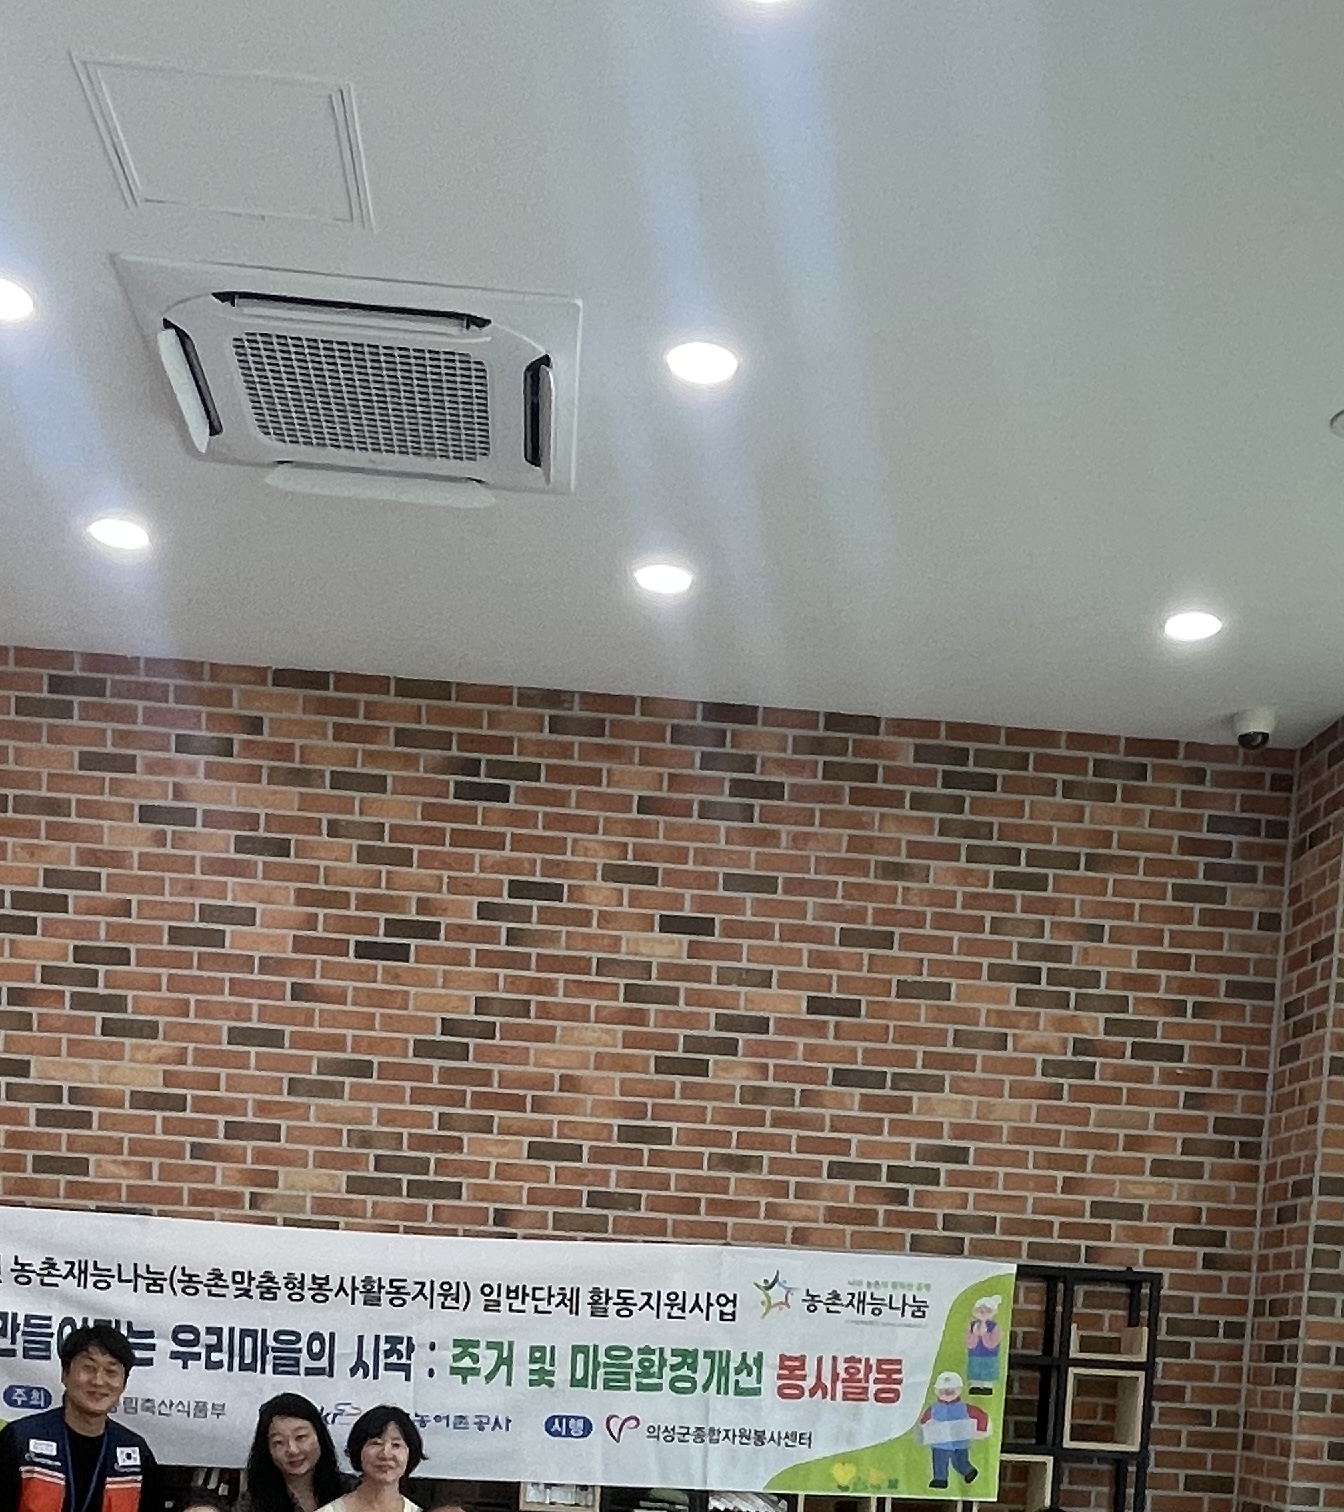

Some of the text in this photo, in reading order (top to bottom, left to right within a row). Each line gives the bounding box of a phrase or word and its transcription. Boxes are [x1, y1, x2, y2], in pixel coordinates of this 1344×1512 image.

[10, 1254, 471, 1312] 농촌재능나눔(농촌맞춤형봉사활동지원)
[479, 1282, 581, 1316] 일반단체
[587, 1286, 738, 1322] 활동지원사업
[801, 1288, 930, 1319] 농촌재능나눔
[169, 1324, 336, 1379] 우리마을의
[349, 1334, 416, 1382] 시작
[449, 1338, 515, 1388] 주거
[528, 1345, 556, 1388] 및
[569, 1343, 764, 1397] 마을환경개선
[776, 1353, 904, 1404] 봉사활동
[550, 1417, 584, 1437] 시행
[646, 1424, 813, 1449] 의성군종합자원봉사센터
